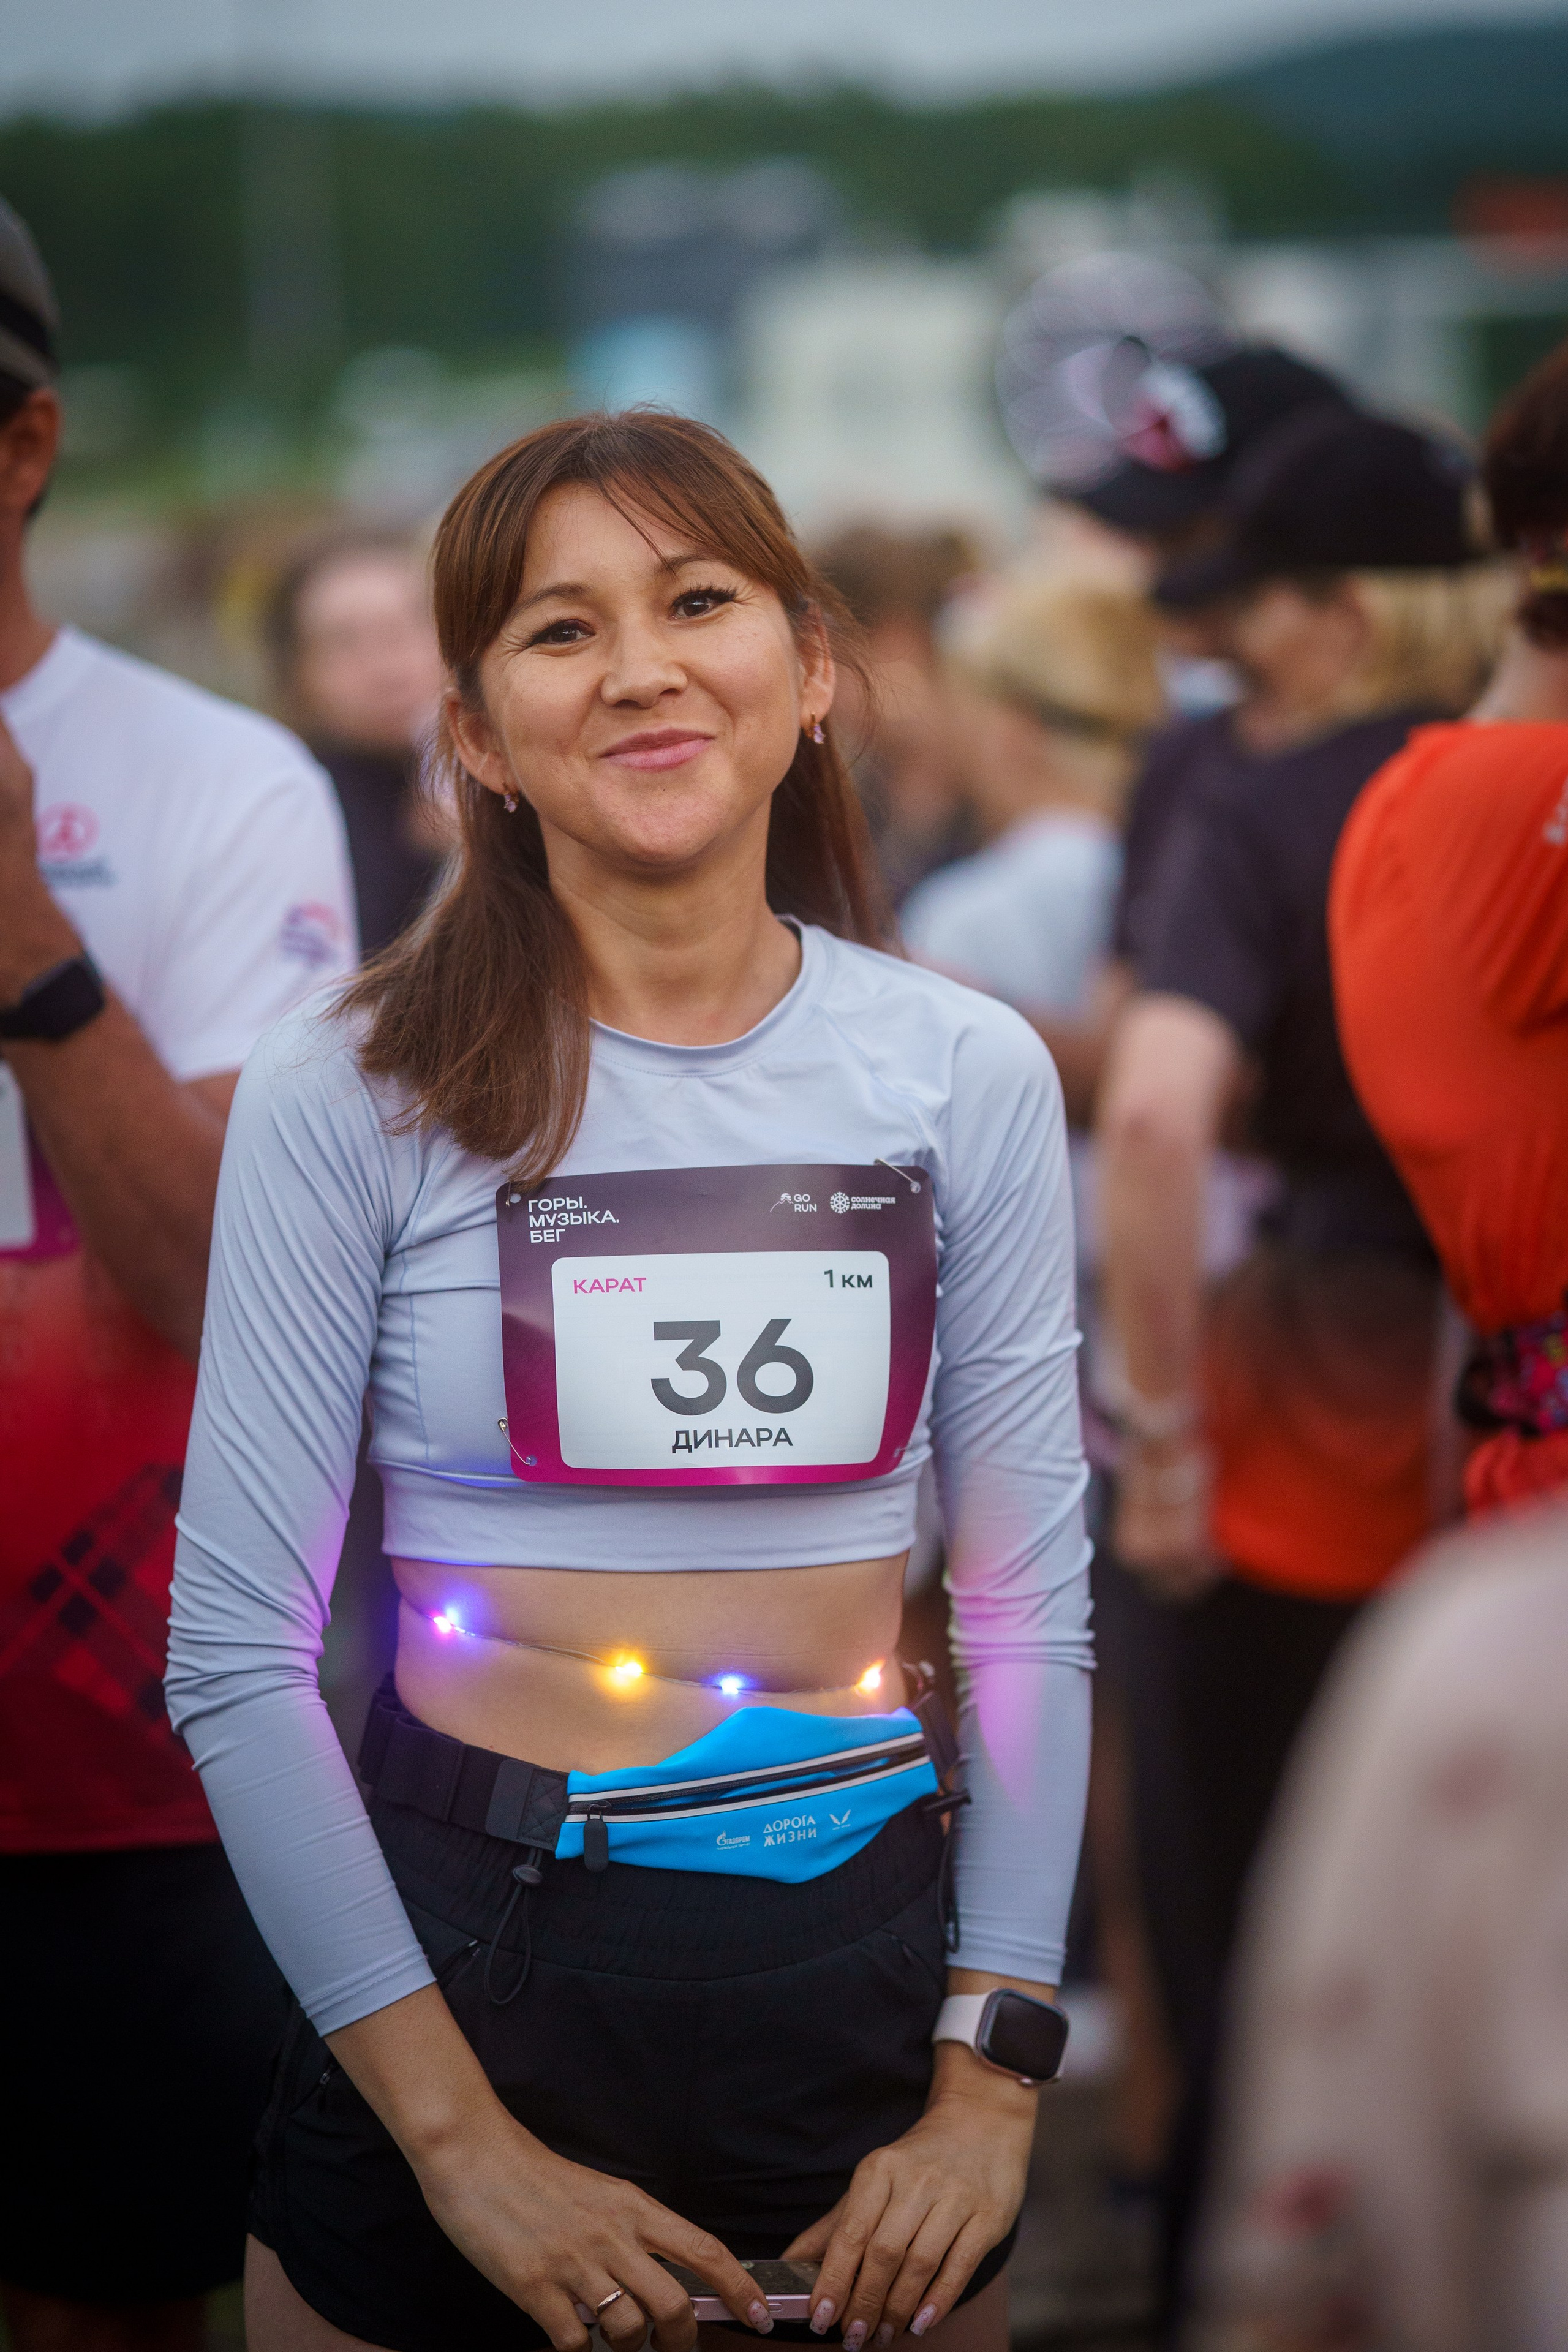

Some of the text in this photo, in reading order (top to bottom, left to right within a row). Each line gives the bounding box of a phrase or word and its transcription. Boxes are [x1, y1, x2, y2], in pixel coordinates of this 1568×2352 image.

[528, 1196, 587, 1212] ГОРЫ.
[794, 1194, 810, 1202] GO
[794, 1204, 817, 1212] RUN
[529, 1210, 620, 1227] МУЗЫКА.
[530, 1229, 565, 1243] БЕГ
[573, 1276, 647, 1294] КАРАТ
[824, 1269, 834, 1288] 1
[650, 1318, 814, 1416] 36
[671, 1427, 793, 1453] ДИНАРА
[763, 1815, 816, 1833] ДОРОГА
[764, 1828, 817, 1847] ЖИЗНИ
